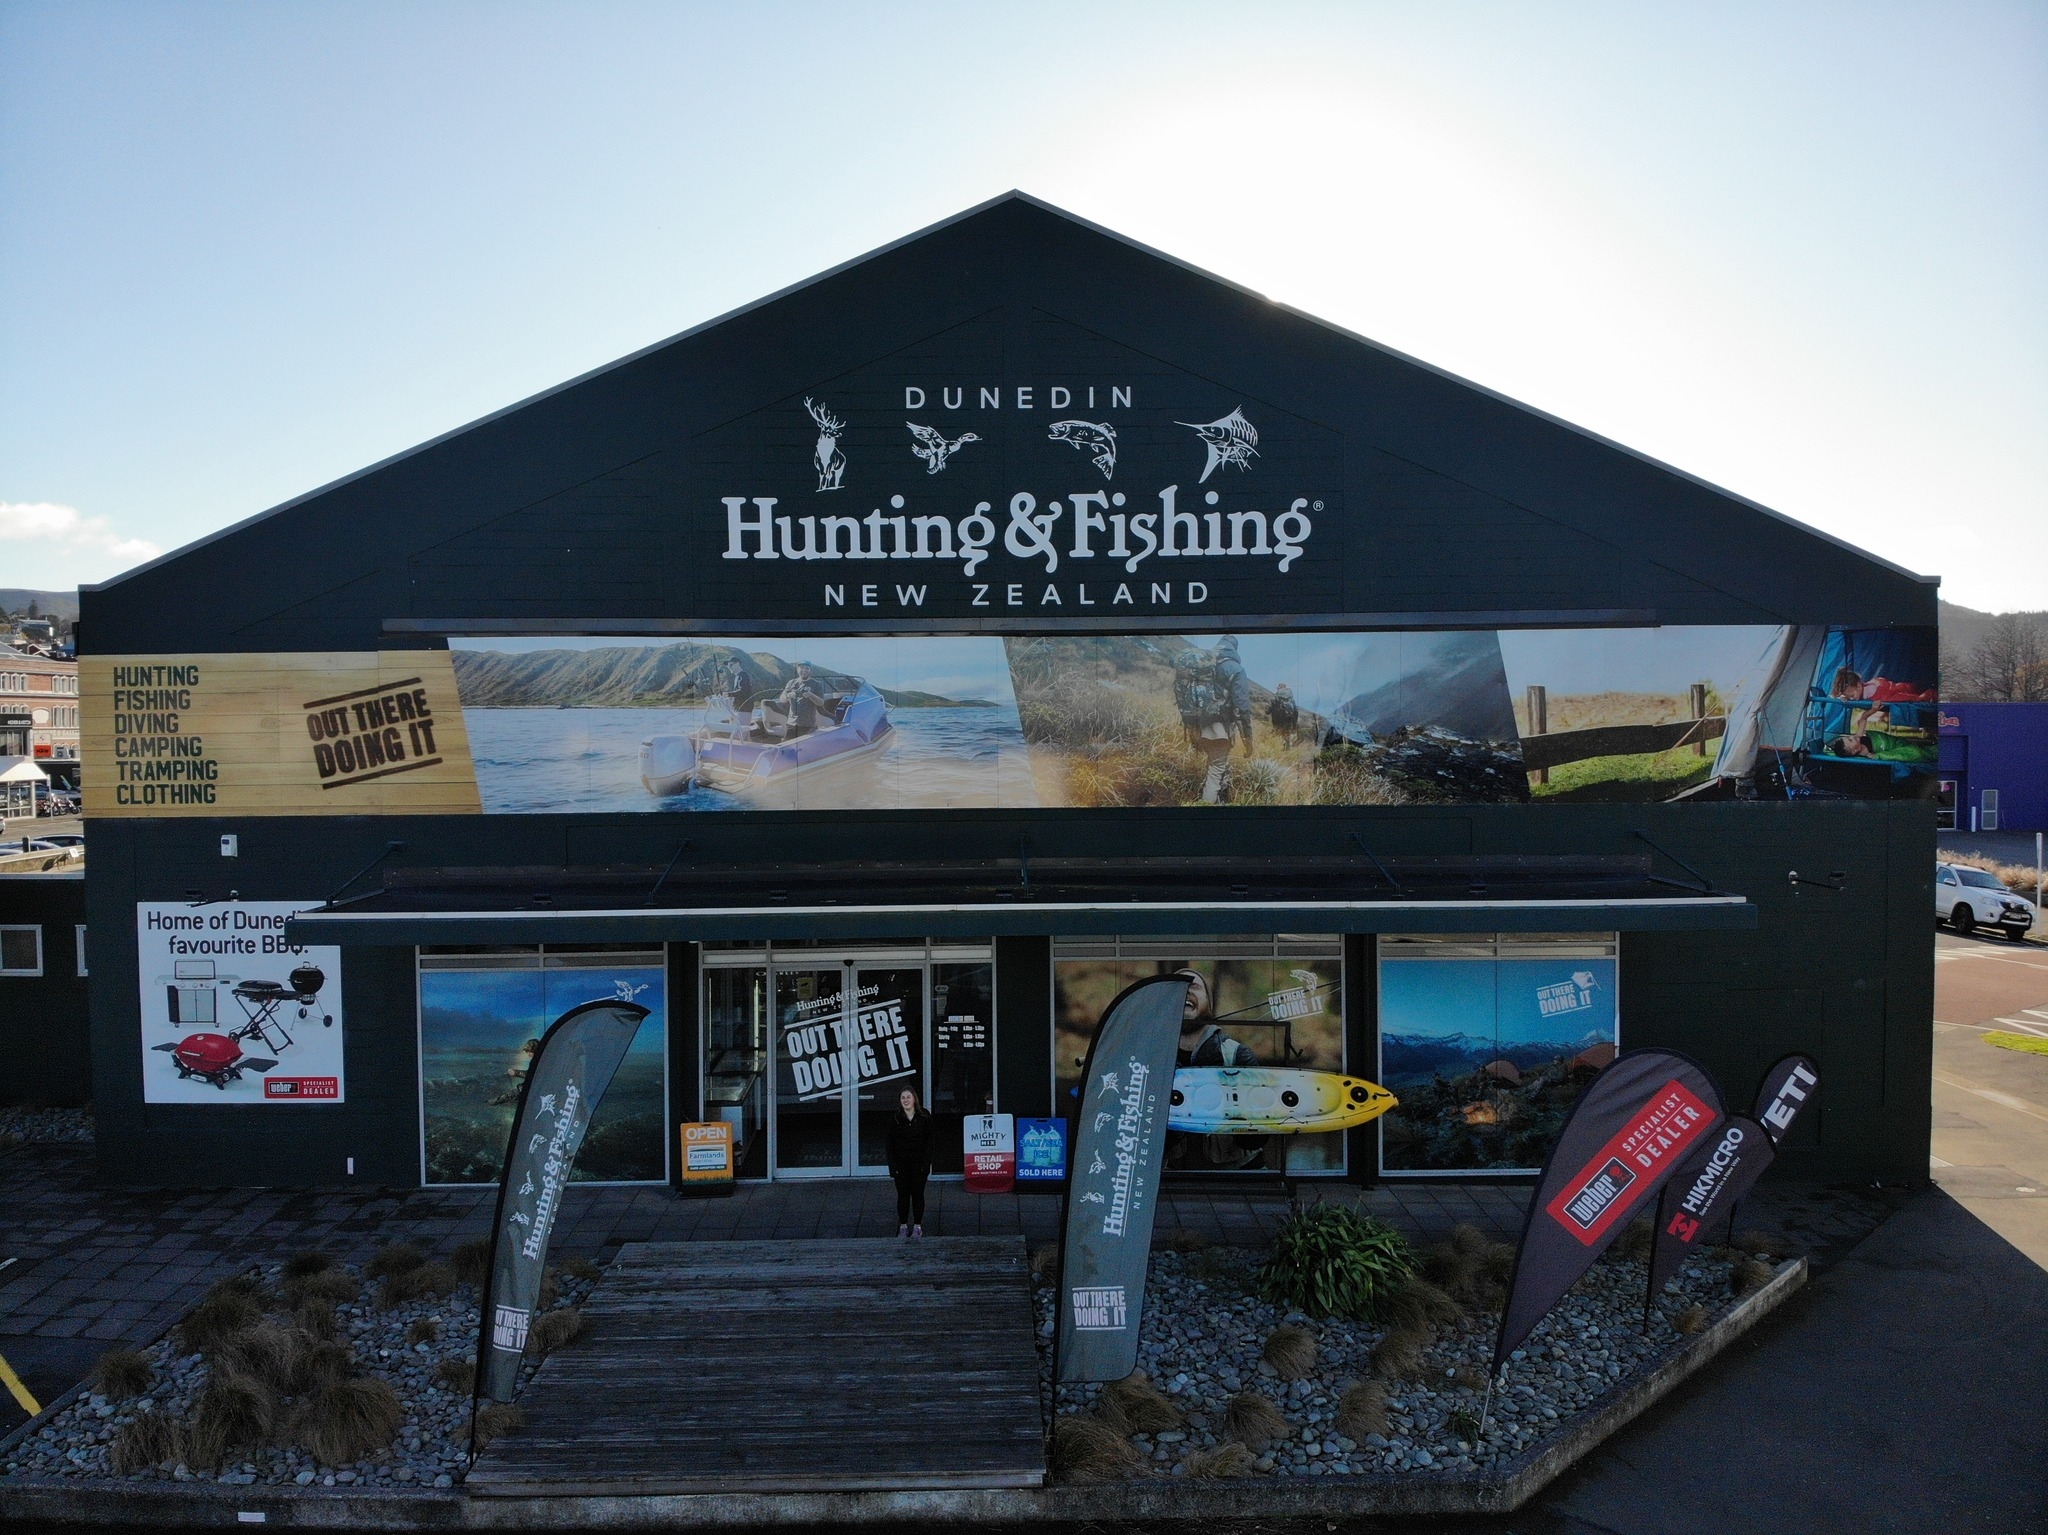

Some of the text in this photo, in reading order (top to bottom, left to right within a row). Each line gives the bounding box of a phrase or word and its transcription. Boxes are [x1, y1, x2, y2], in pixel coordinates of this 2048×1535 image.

[905, 386, 1131, 410] DUNEDIN
[825, 582, 1208, 606] NEW ZEALAND
[113, 665, 199, 687] HUNTING
[113, 689, 191, 710] FISHING
[114, 713, 179, 734] DIVING
[306, 688, 432, 742] OUT THERE
[115, 736, 203, 758] CAMPING
[313, 718, 437, 778] DOING IT
[115, 759, 218, 781] TRAMPING
[116, 783, 217, 805] CLOTHING
[147, 910, 204, 930] Home
[209, 910, 230, 930] of
[169, 935, 256, 954] favourite
[1283, 989, 1307, 1003] THERE
[1537, 983, 1575, 1000] OUT THERE
[1539, 989, 1591, 1015] DOING IT
[1270, 995, 1323, 1020] DOING IT
[786, 1006, 906, 1058] OUT THERE
[791, 1034, 912, 1094] DOING IT
[1760, 1065, 1817, 1143] ETI
[685, 1127, 727, 1140] OPEN
[1621, 1092, 1682, 1153] SPECIALIST
[971, 1131, 1007, 1141] MIGHTY
[1636, 1105, 1701, 1168] DEALER
[974, 1155, 1004, 1163] RETAIL
[1133, 1094, 1156, 1210] NEW ZEALAND
[1019, 1168, 1063, 1177] SOLD HERE
[1681, 1127, 1744, 1213] HIKMICRO
[1570, 1173, 1617, 1222] weber
[1072, 1290, 1126, 1308] OUT THERE
[1074, 1306, 1126, 1327] DOING IT
